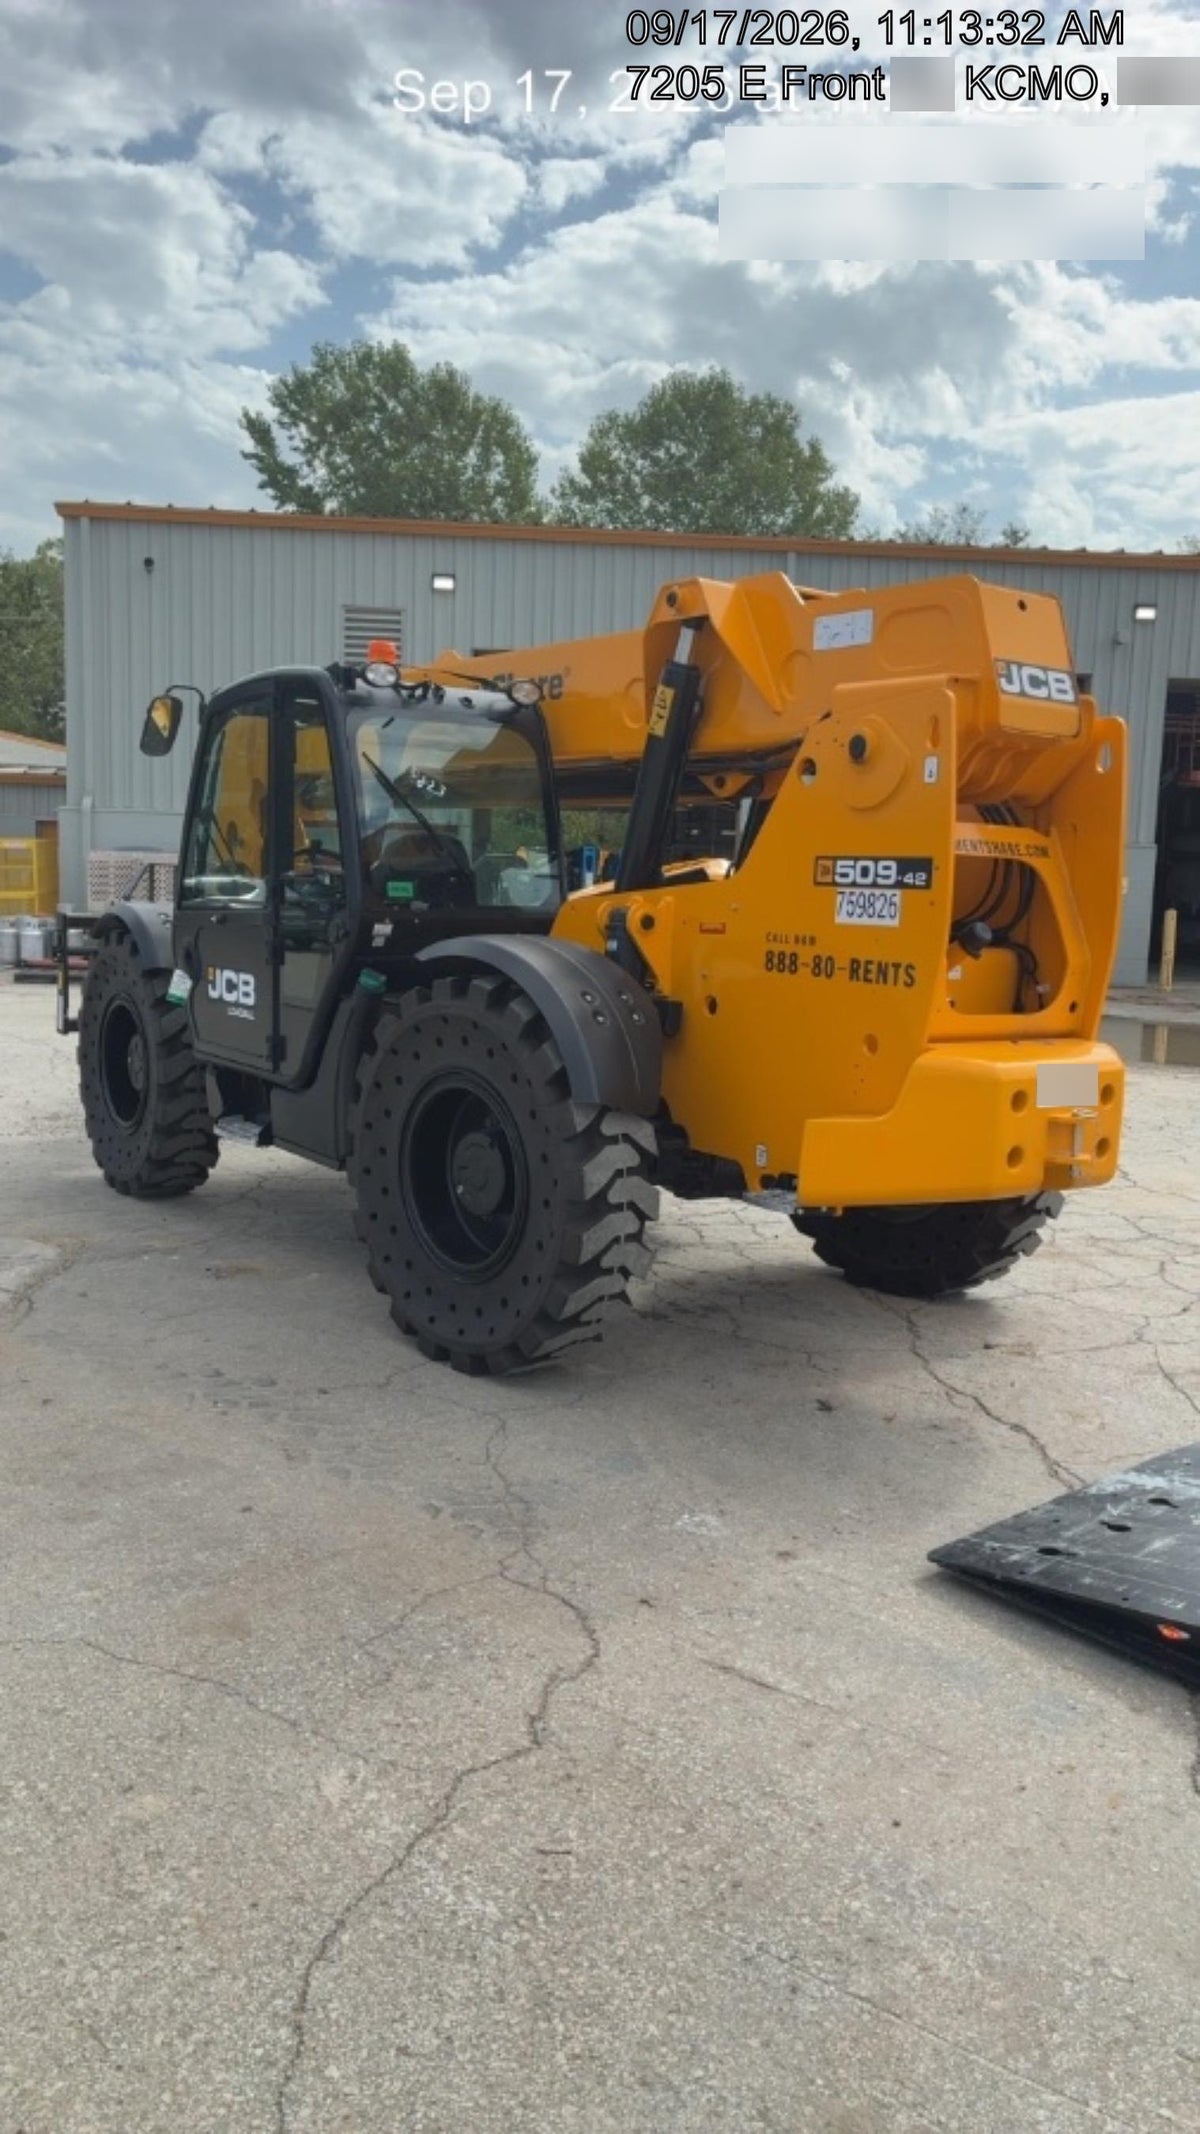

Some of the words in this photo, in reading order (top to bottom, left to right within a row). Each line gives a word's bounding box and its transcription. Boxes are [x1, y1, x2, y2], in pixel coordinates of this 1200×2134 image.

[996, 661, 1076, 703] JCB
[837, 890, 898, 920] 759826
[207, 965, 255, 1007] JCB
[764, 949, 916, 988] 888-80-RENTS
